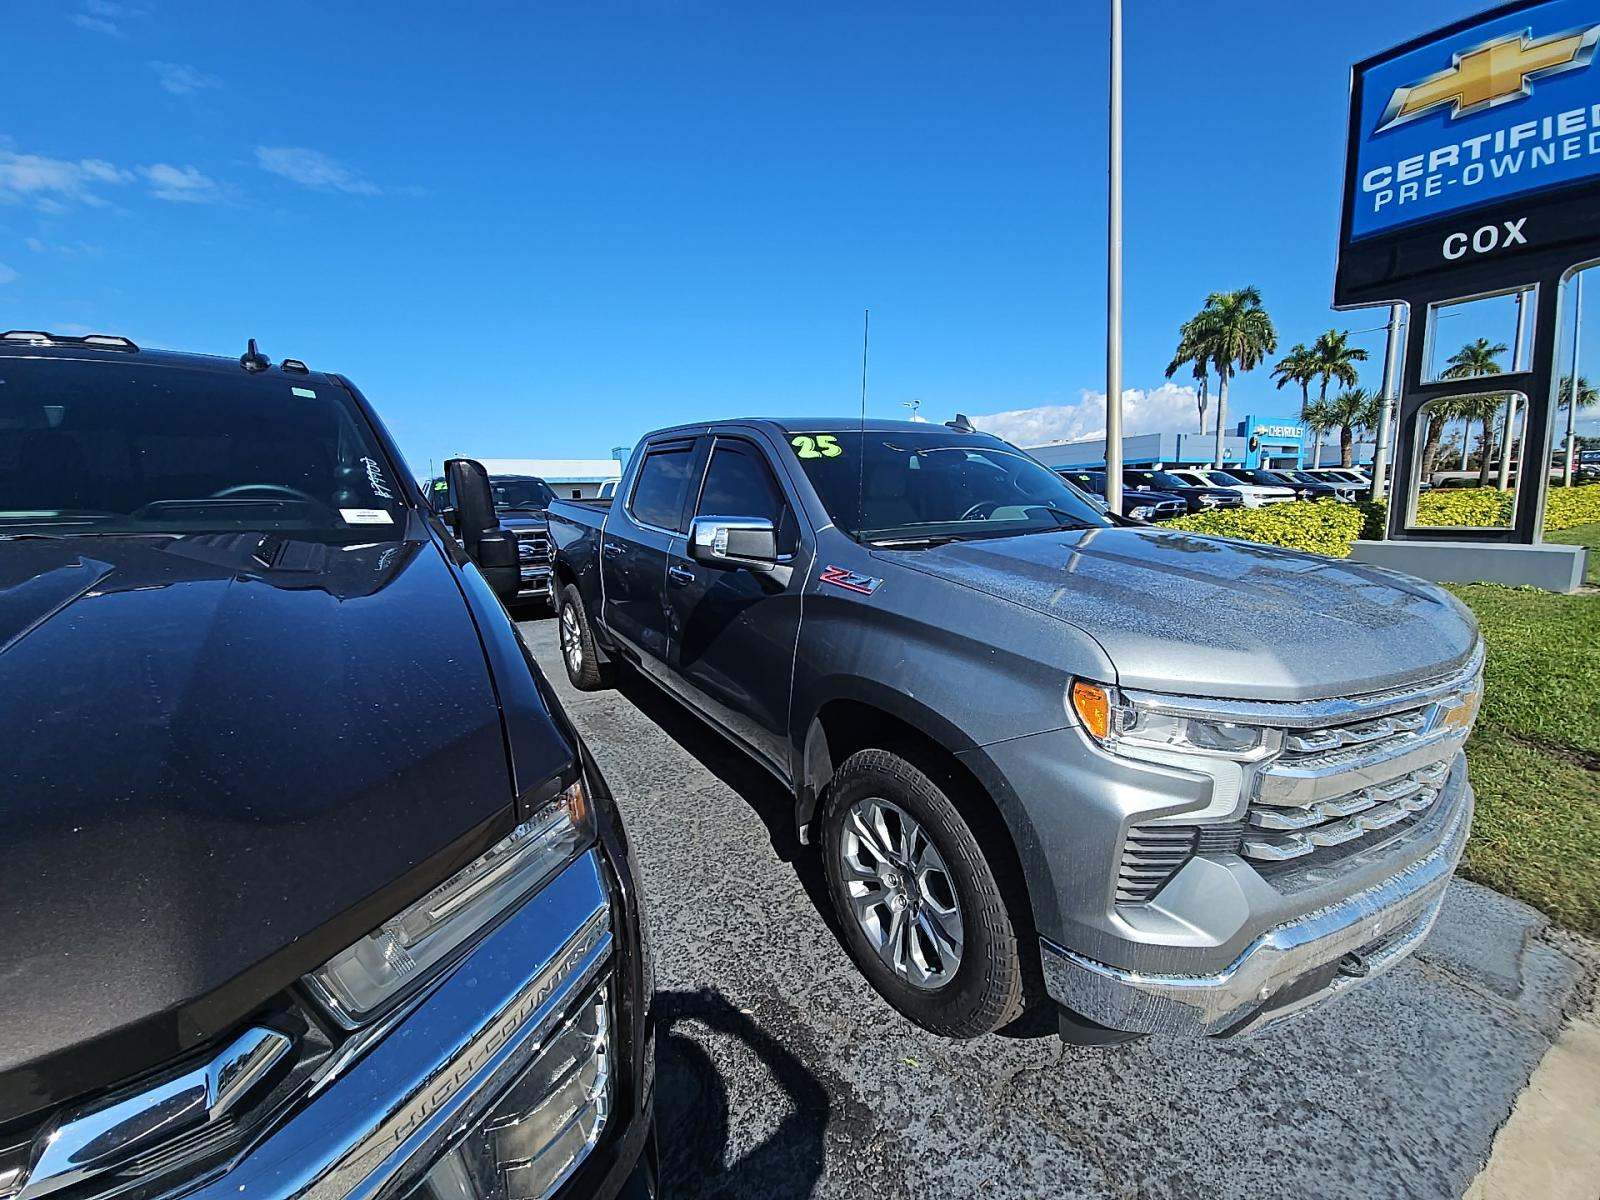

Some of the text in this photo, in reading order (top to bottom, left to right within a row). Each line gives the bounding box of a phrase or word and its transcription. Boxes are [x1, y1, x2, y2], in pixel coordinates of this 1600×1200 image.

[1362, 103, 1600, 194] CERTIFIE
[1442, 217, 1528, 261] COX
[791, 434, 843, 459] 25
[1269, 425, 1305, 438] CHEVROLET
[394, 938, 592, 1142] HIGH COUNTRY
